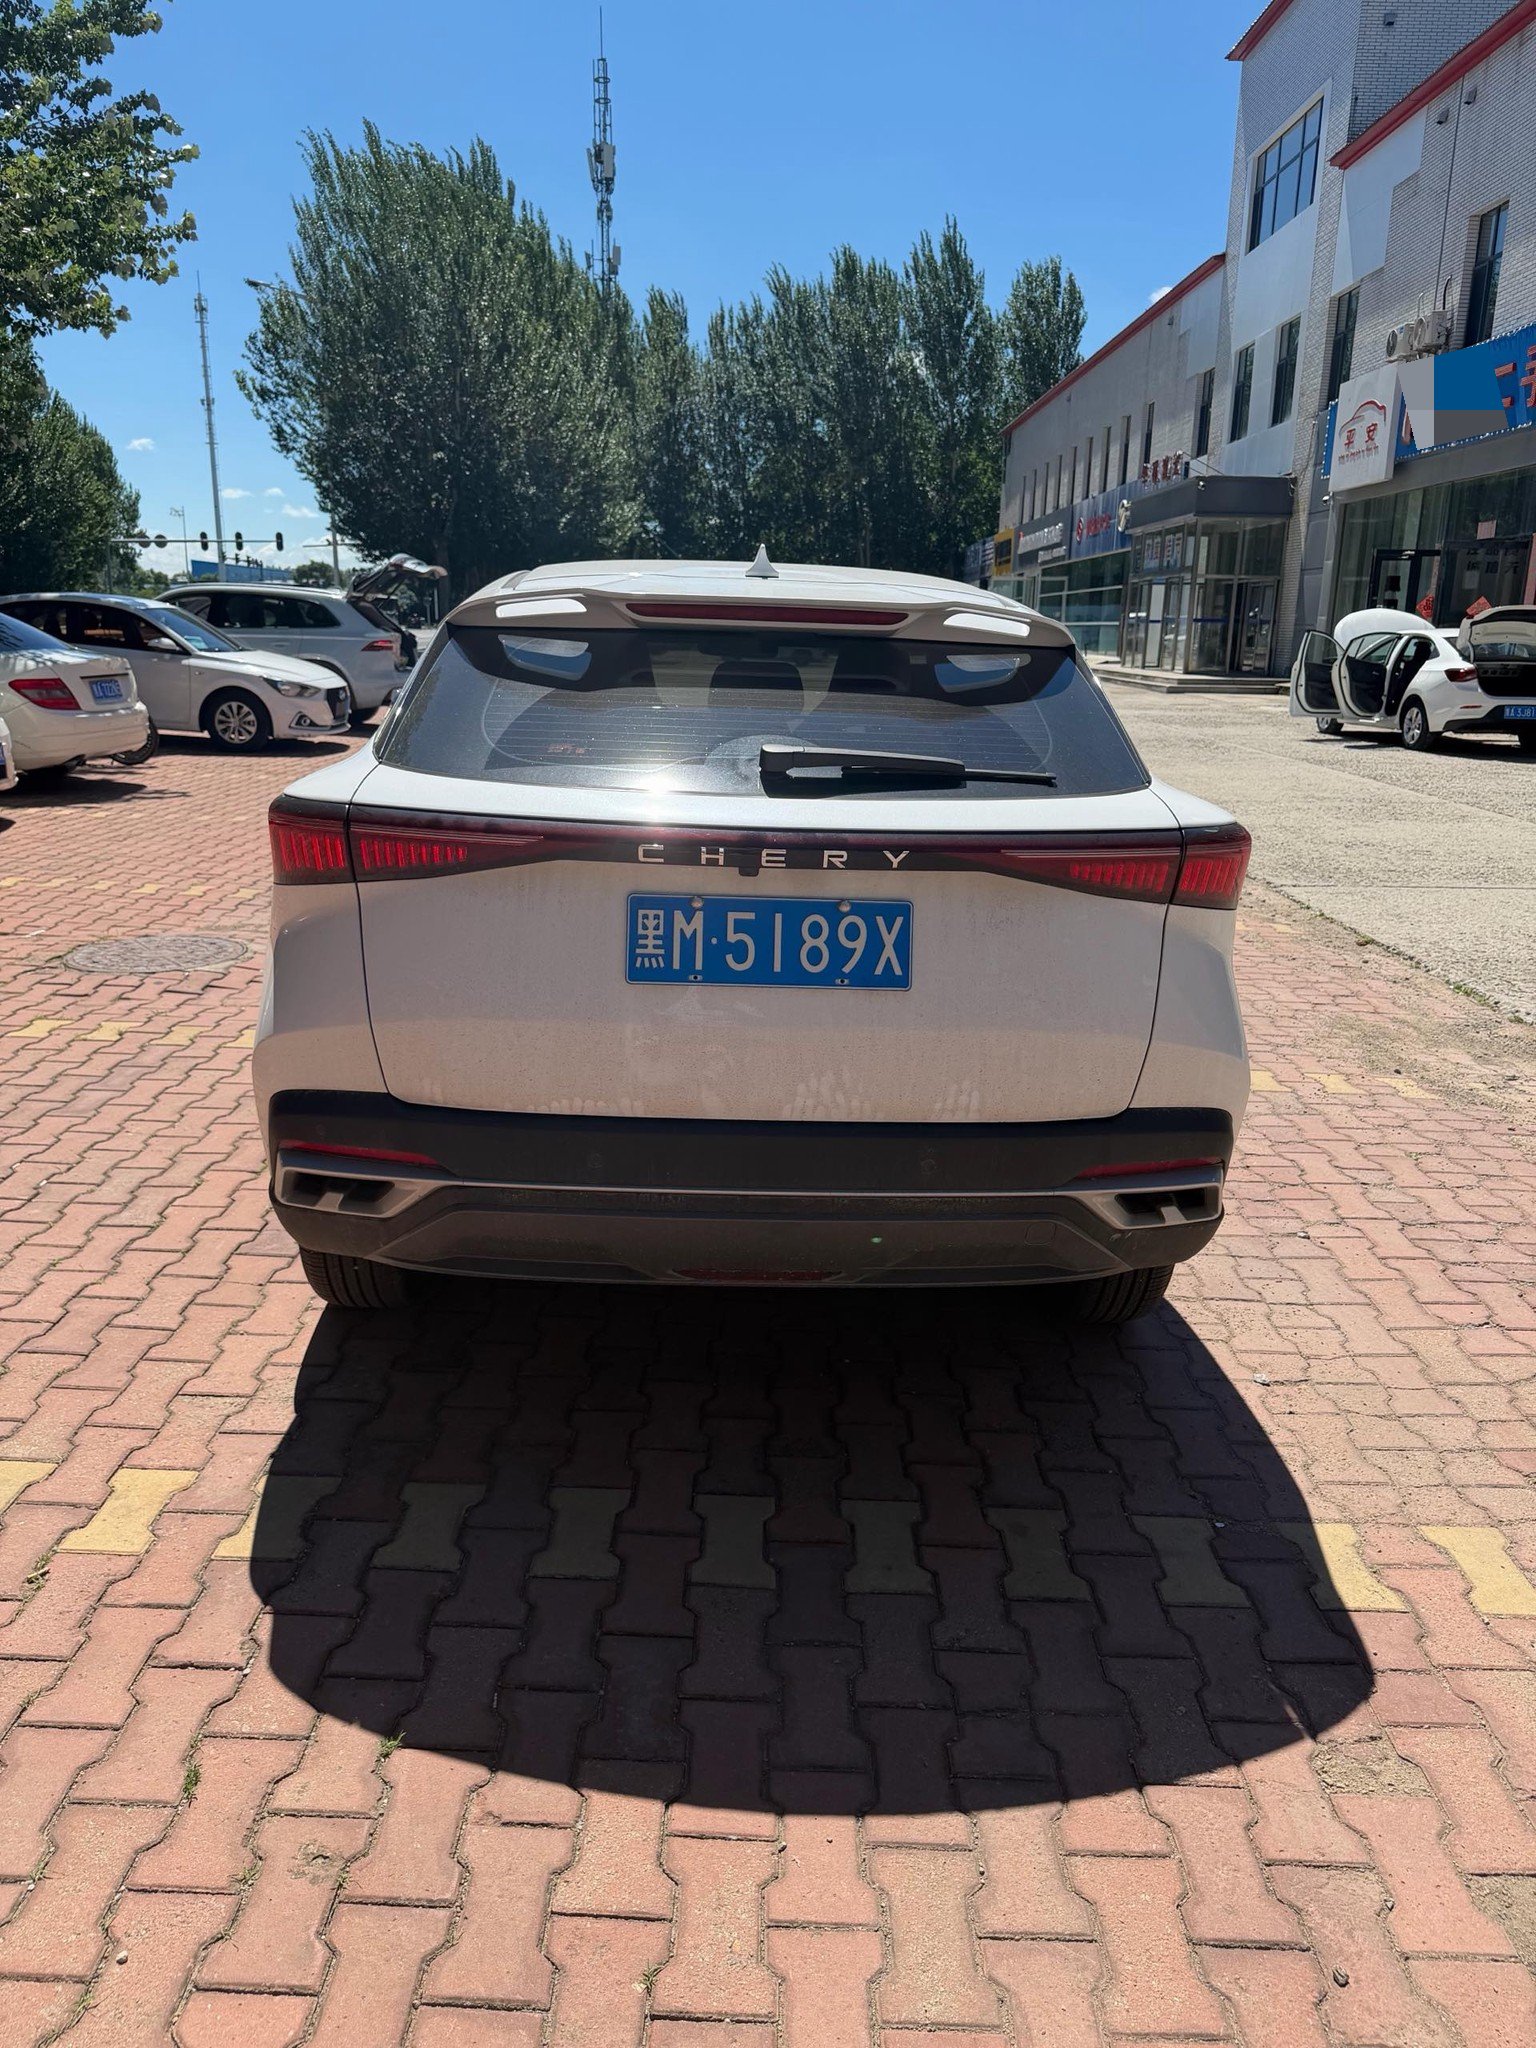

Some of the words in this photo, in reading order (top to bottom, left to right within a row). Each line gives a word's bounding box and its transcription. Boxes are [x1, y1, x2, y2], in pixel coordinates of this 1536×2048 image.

[1344, 422, 1378, 448] 平安
[637, 844, 910, 869] CHERY
[636, 909, 904, 976] 黑M·5189X
